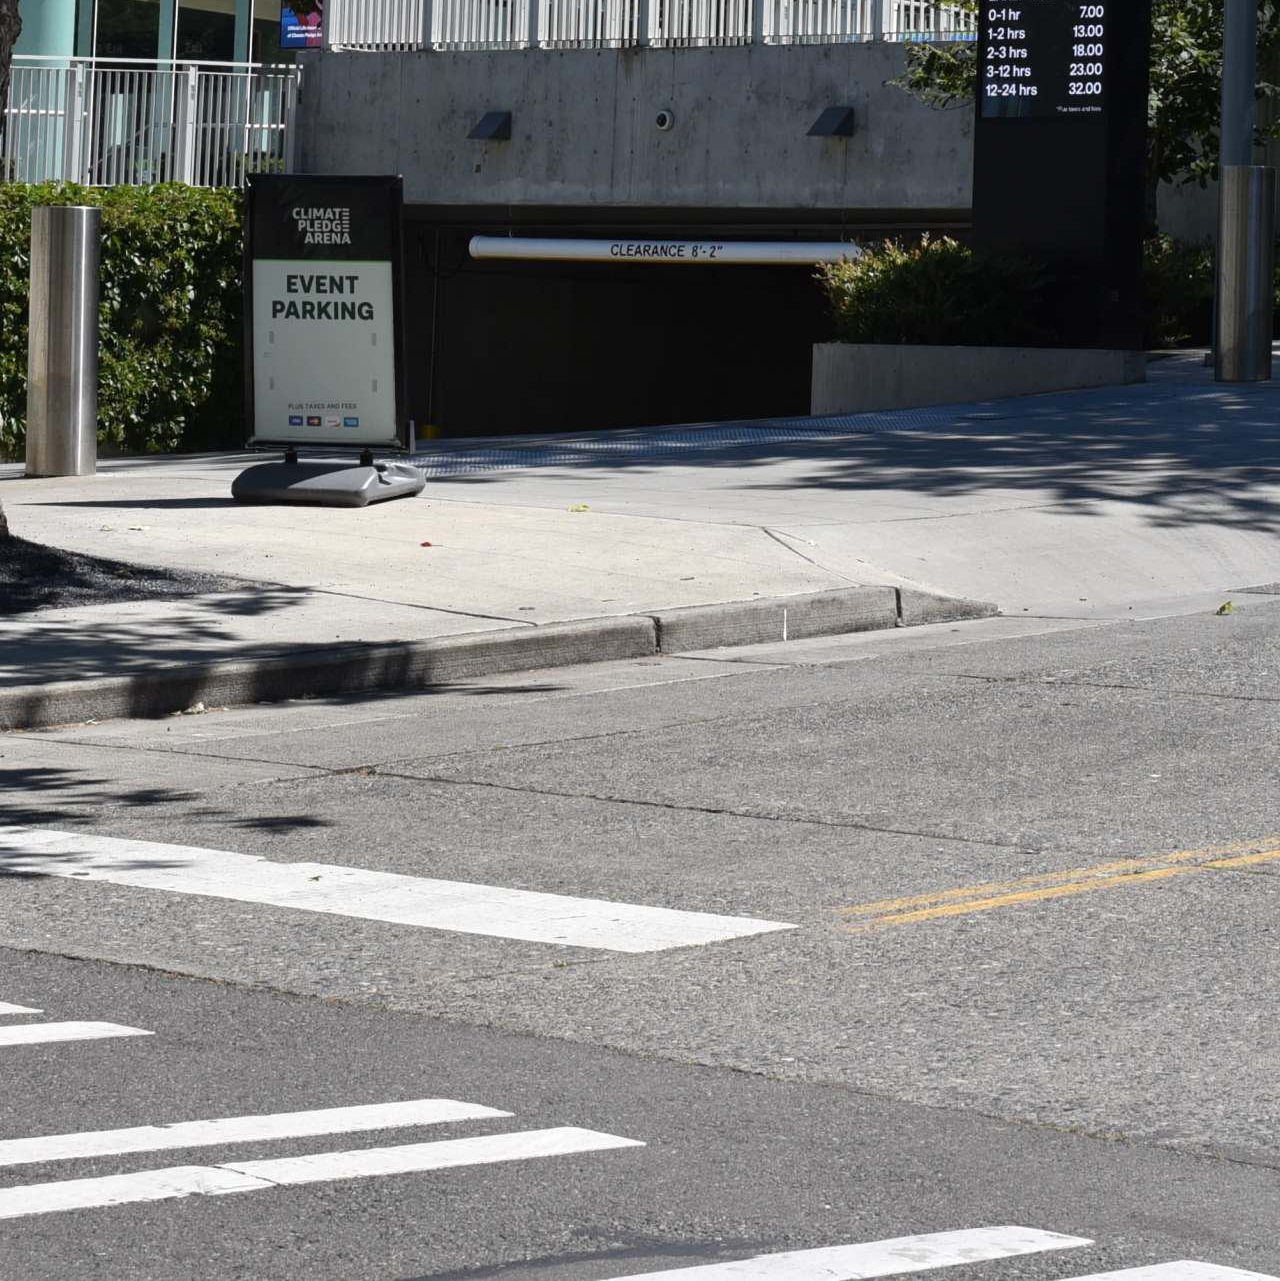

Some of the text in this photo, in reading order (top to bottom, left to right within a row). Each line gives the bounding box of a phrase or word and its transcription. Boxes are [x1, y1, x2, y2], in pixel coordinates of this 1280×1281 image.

[988, 5, 1104, 21] 0-1 hr 7.00
[987, 24, 1104, 40] 1-2 hrs 13.00
[986, 43, 1104, 59] 2-3 hrs 18.00
[986, 62, 1103, 78] 3-12 hrs 23.00
[985, 81, 1102, 97] 12-24 hrs 32.00
[292, 207, 350, 220] CLIMATE
[298, 220, 350, 232] PLEDGE
[304, 232, 351, 244] ARENA
[610, 244, 686, 258] CLEARANCE
[286, 274, 359, 295] EVENT
[272, 300, 374, 321] PARKING
